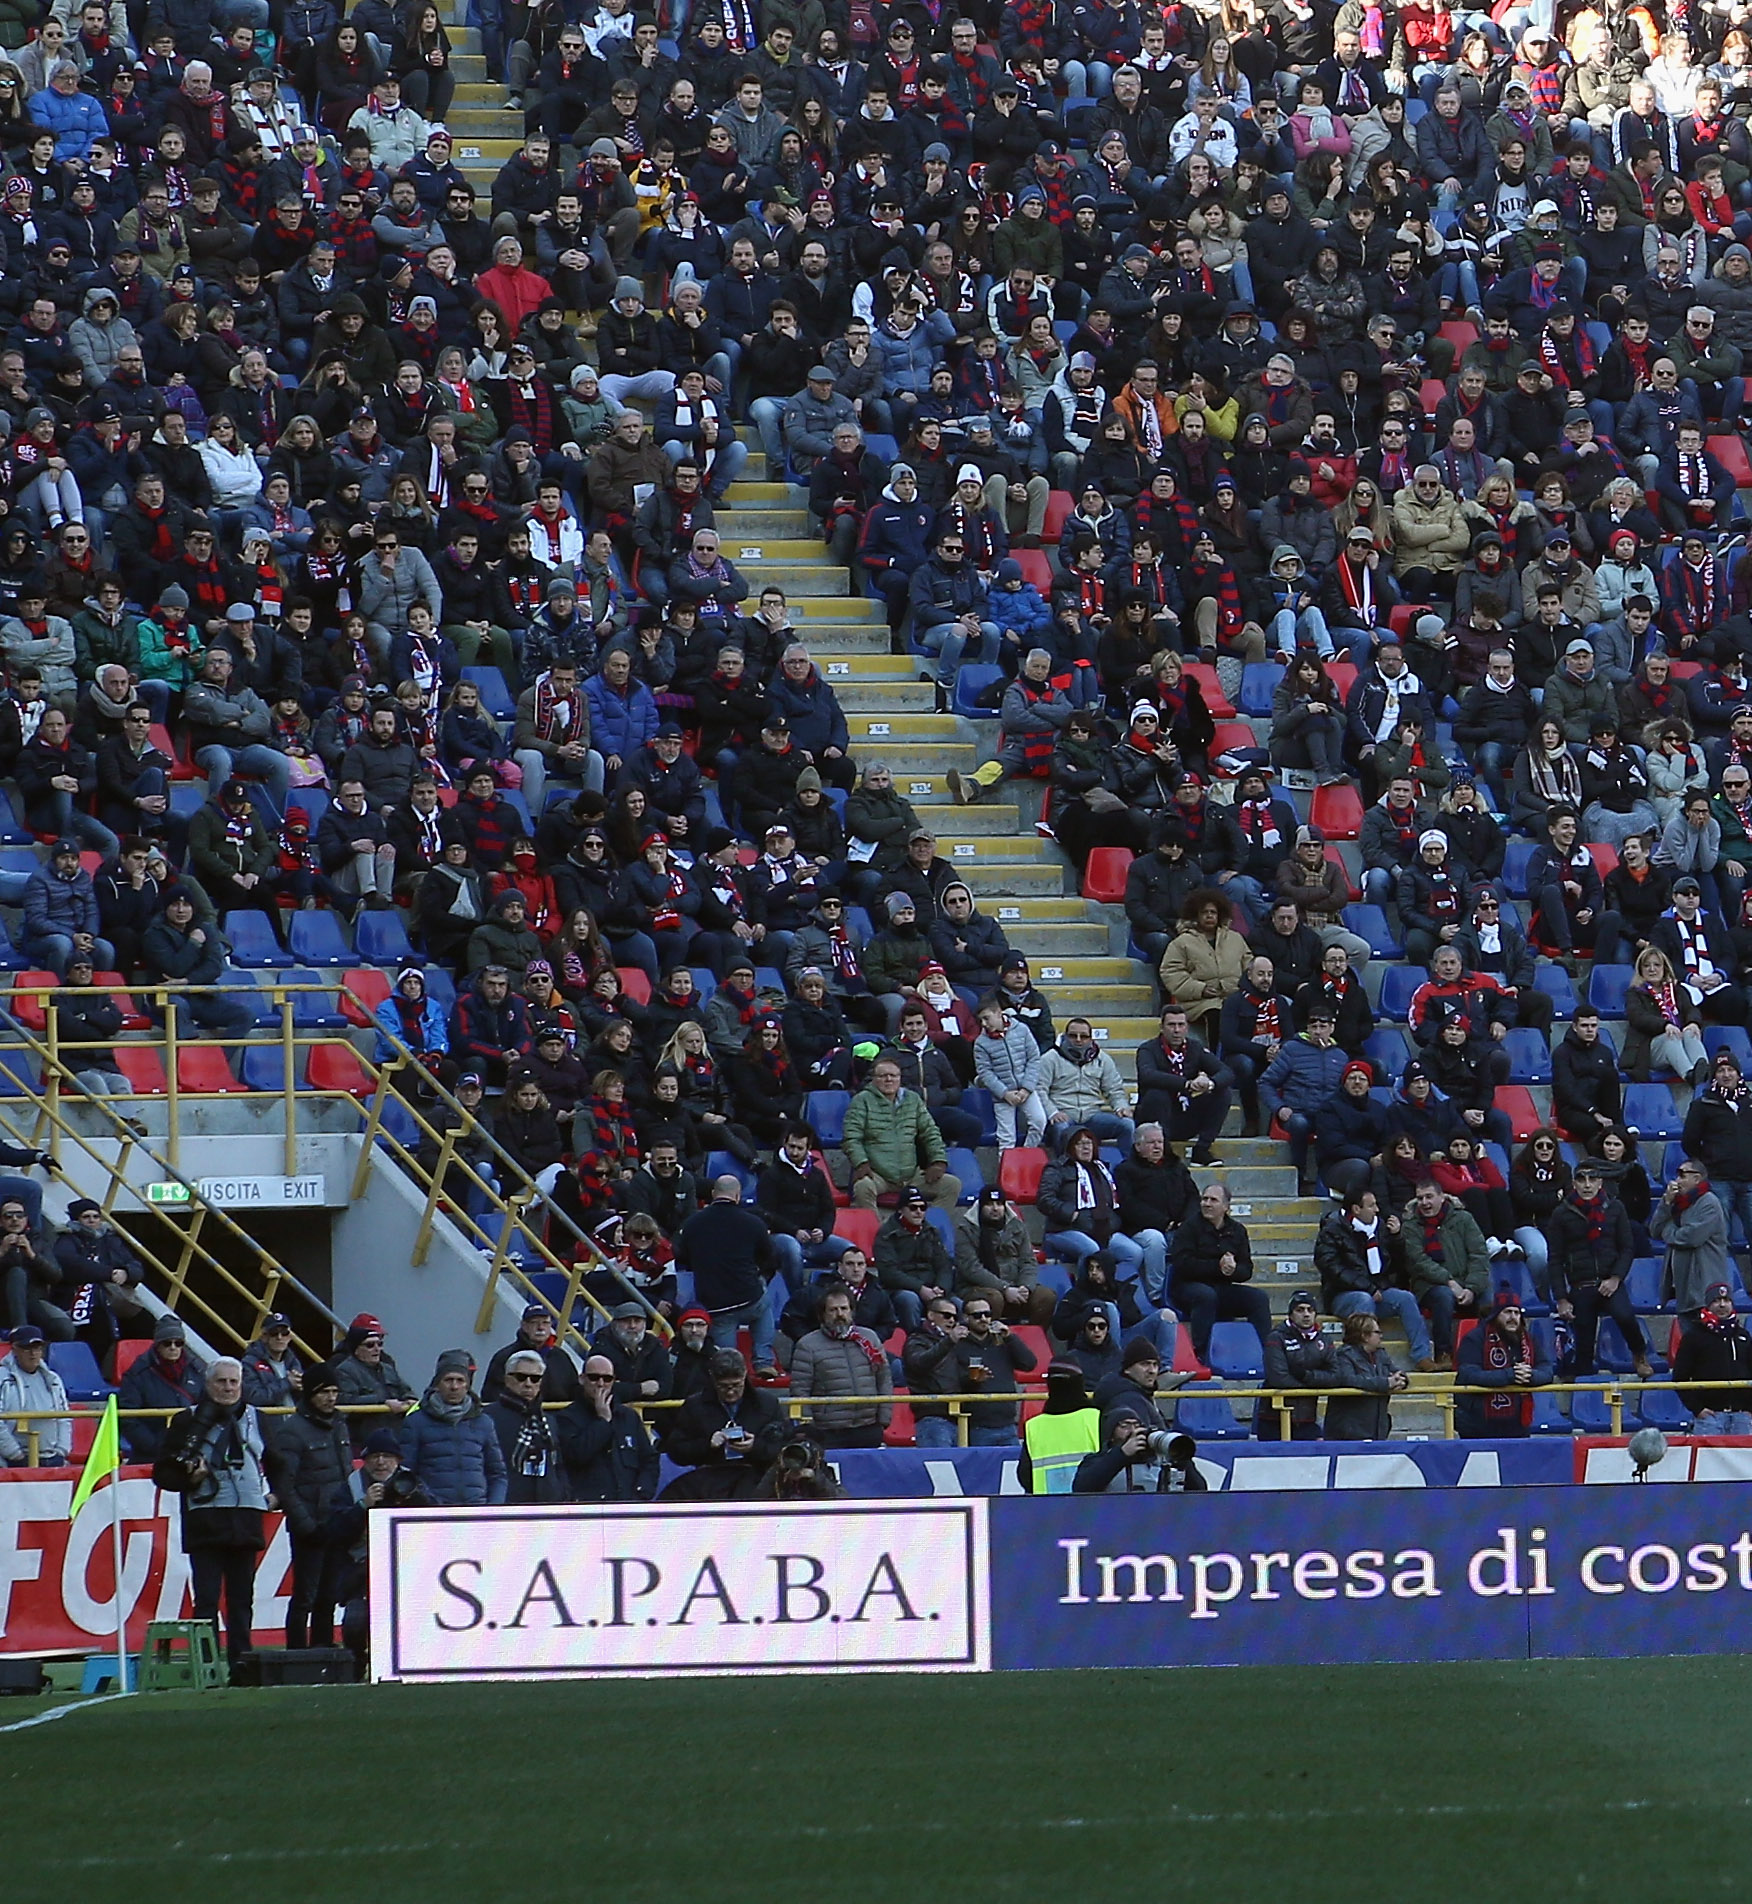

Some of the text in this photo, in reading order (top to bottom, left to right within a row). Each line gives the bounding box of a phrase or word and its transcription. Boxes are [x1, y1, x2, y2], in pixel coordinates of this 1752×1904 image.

[201, 1181, 318, 1200] USCITA EXIT
[436, 1554, 939, 1630] S.A.P.A.B.A.
[1059, 1539, 1441, 1619] Impresa
[1468, 1529, 1555, 1595] di
